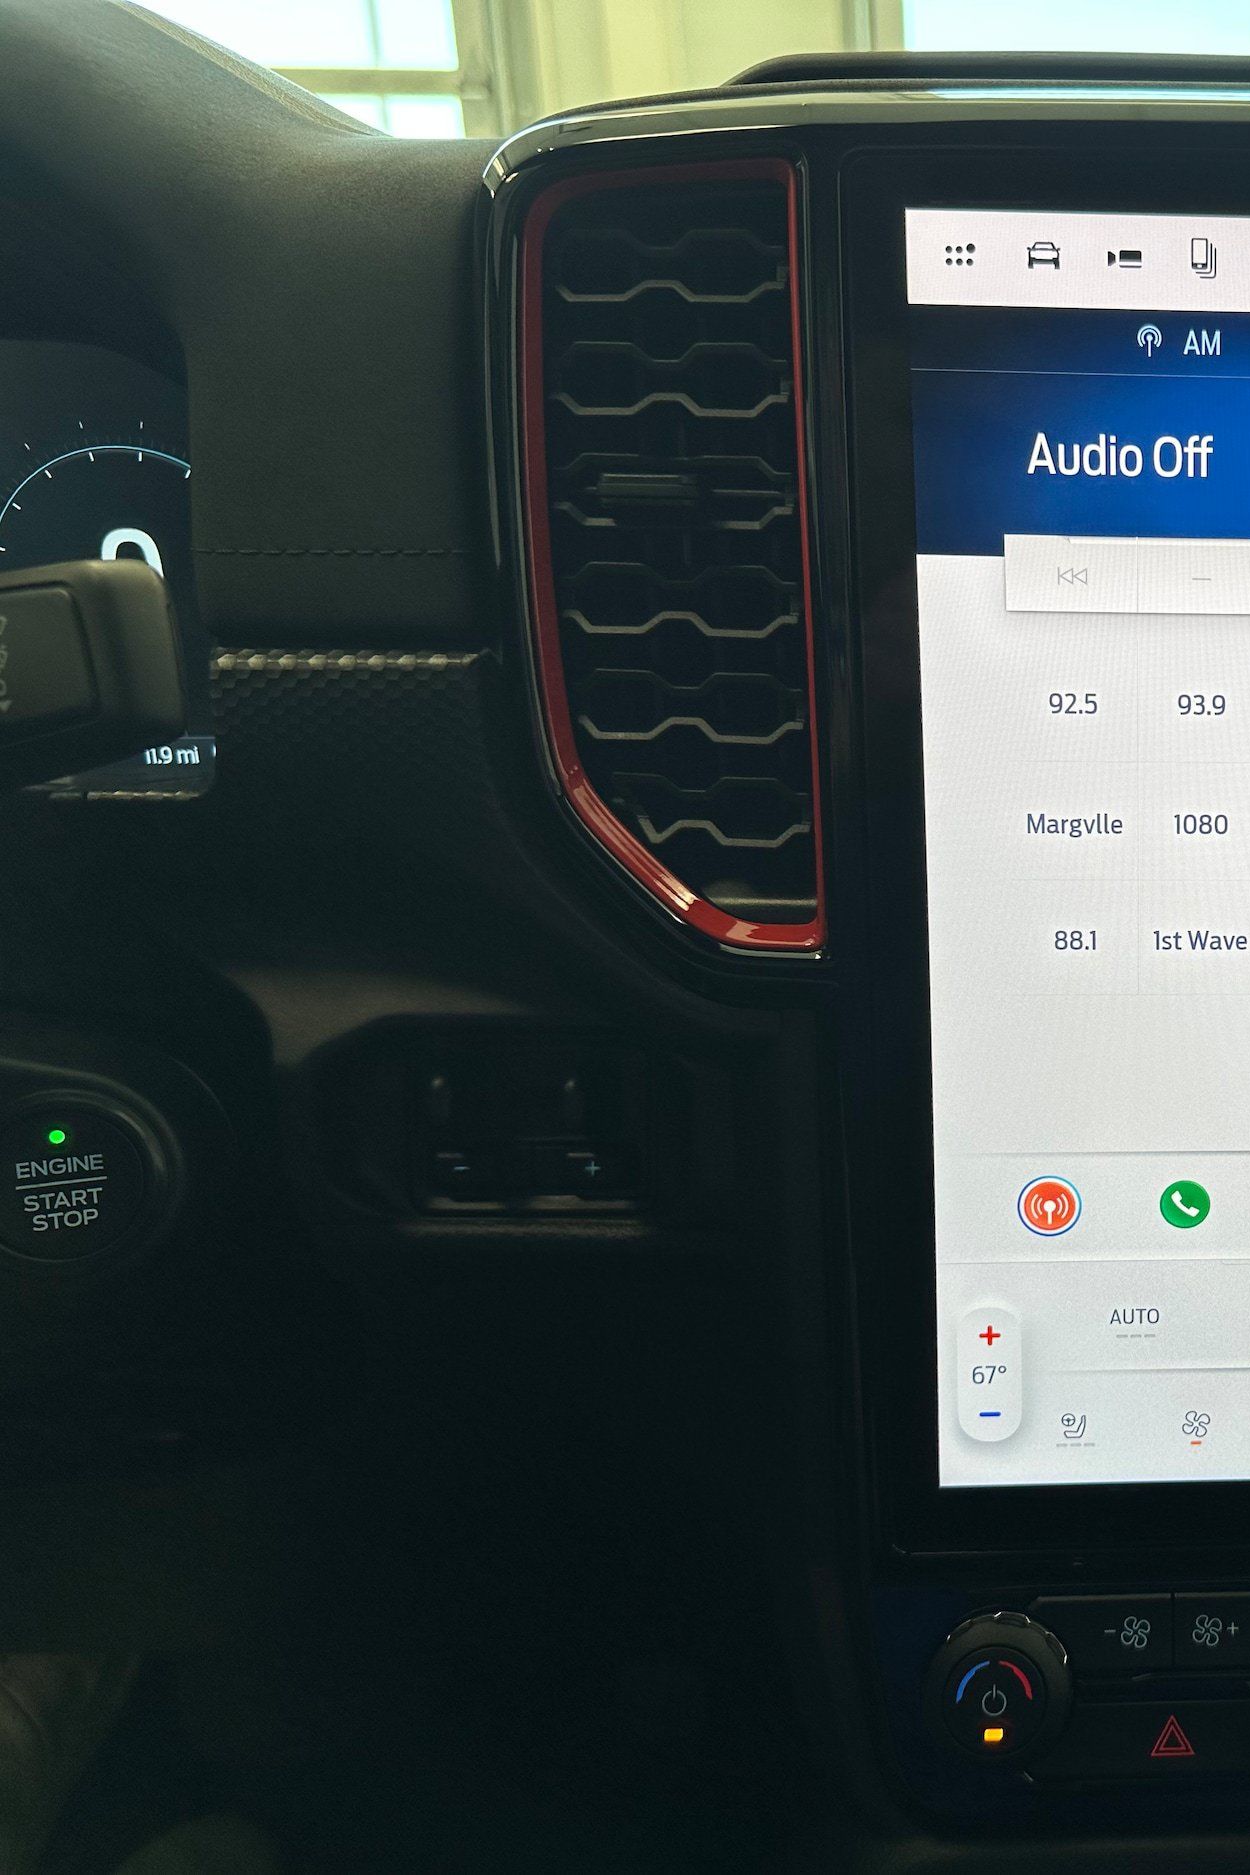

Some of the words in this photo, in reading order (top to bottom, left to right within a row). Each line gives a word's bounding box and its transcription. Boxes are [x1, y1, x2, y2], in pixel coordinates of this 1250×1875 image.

[1182, 328, 1222, 357] AM
[1027, 431, 1144, 478] Audio
[1152, 434, 1214, 479] Off
[1048, 692, 1099, 716] 92.5
[1176, 693, 1227, 717] 93.9
[176, 745, 200, 765] mi
[1026, 812, 1124, 839] Margvlle
[1173, 813, 1229, 836] 1080
[1053, 929, 1098, 952] 88.1
[1153, 929, 1183, 952] 1st
[1187, 930, 1249, 952] Wave
[15, 1154, 104, 1179] ENGINE
[23, 1187, 103, 1212] START
[32, 1208, 99, 1231] STOP
[1109, 1308, 1161, 1326] AUTO
[971, 1365, 1008, 1385] 67°
